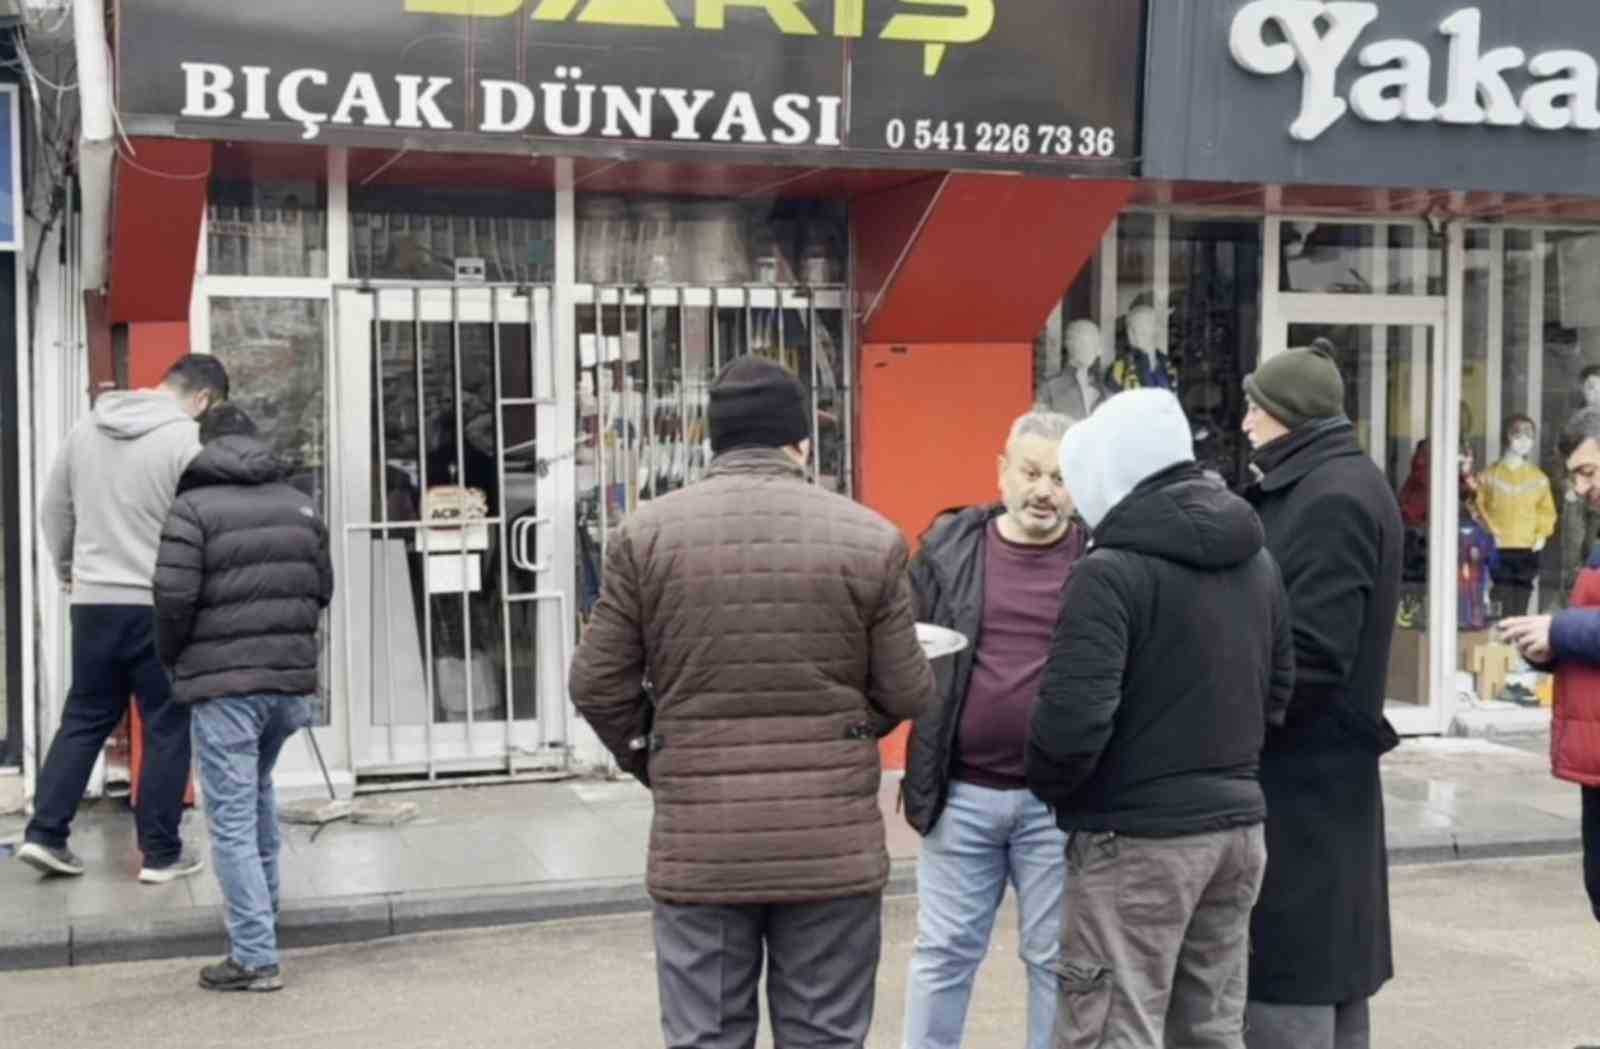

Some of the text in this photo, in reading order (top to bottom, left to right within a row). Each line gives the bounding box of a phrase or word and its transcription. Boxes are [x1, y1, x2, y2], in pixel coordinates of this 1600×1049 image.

[180, 61, 842, 146] BIÇAK DÜNYASI
[1229, 0, 1600, 140] Yaka
[885, 118, 1115, 157] 0 541 226 73 36
